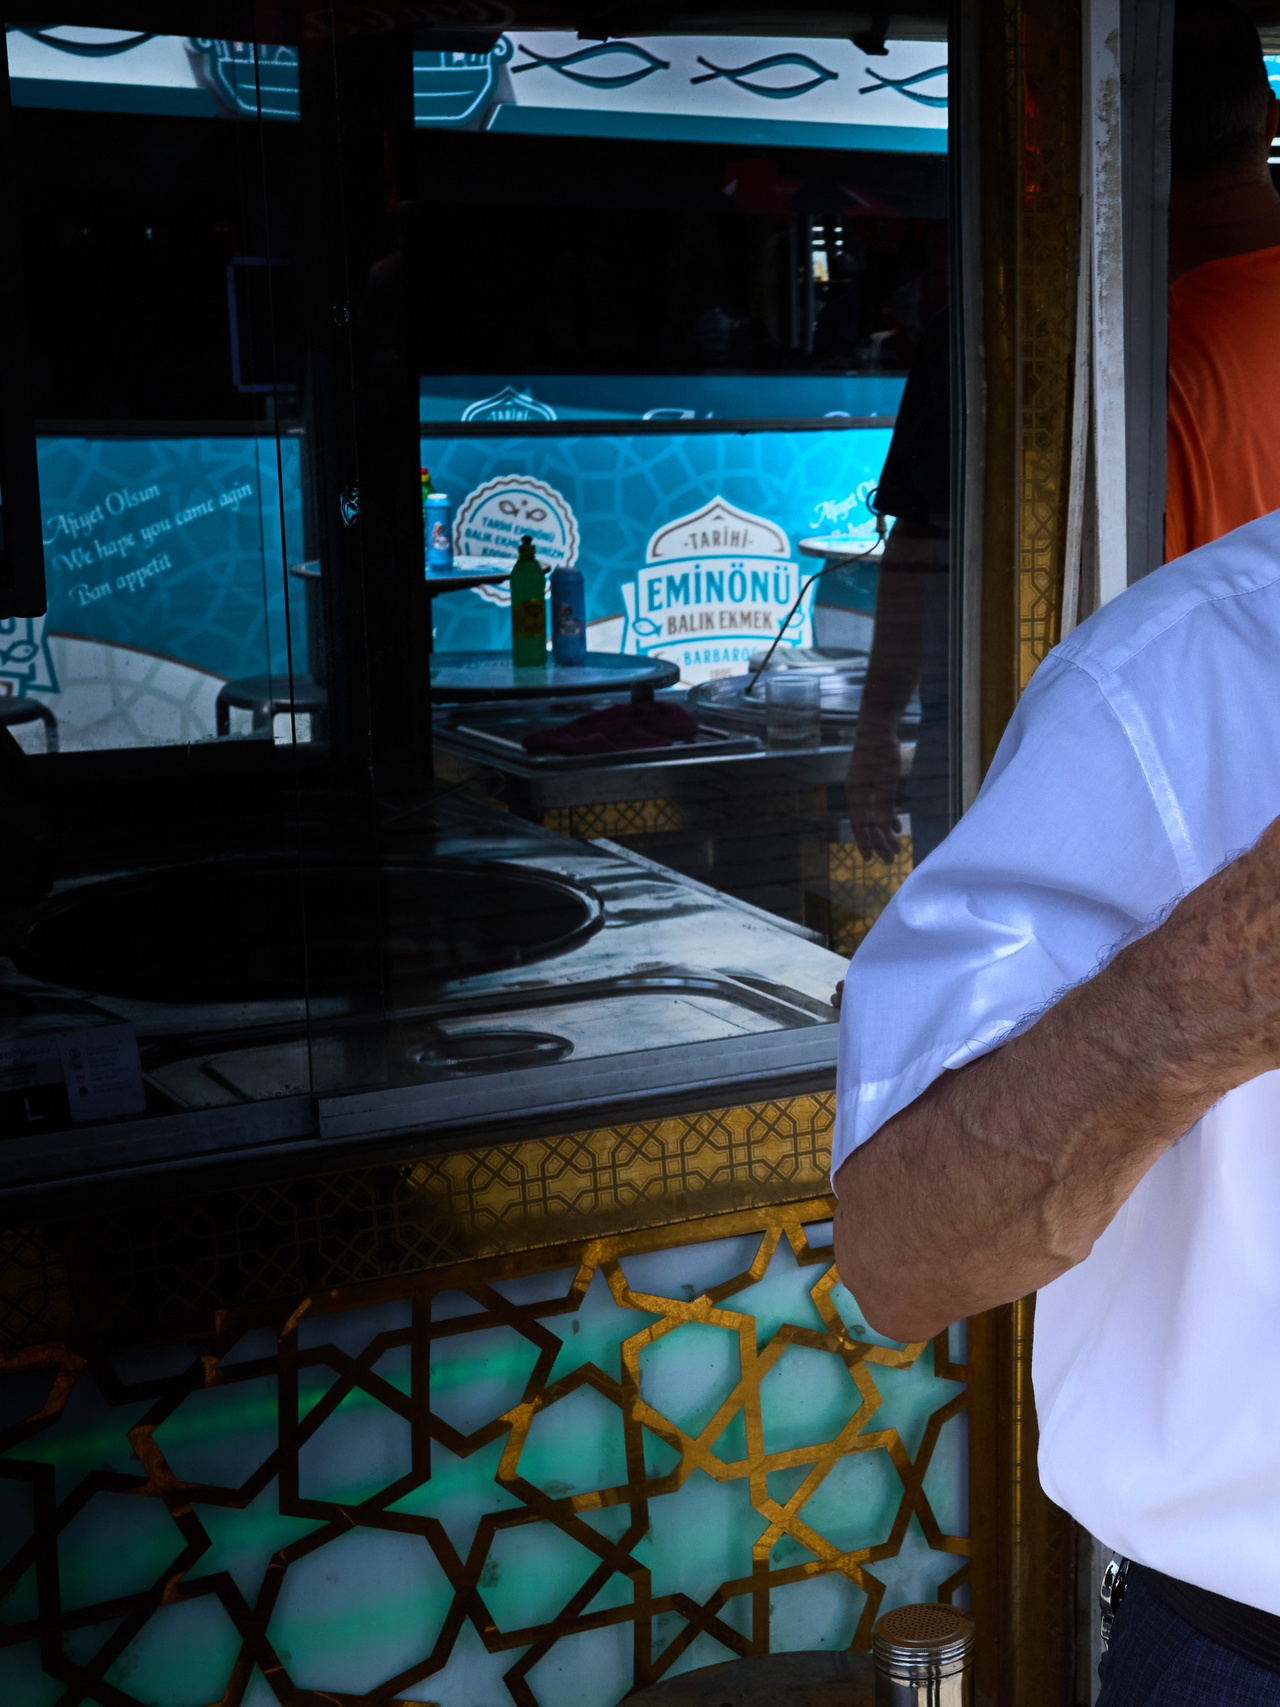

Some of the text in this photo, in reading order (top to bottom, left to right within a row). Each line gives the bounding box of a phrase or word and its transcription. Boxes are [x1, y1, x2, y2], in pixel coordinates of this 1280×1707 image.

[105, 484, 161, 516] Olsun
[141, 518, 171, 548] you
[465, 528, 494, 543] BALIK
[115, 552, 172, 593] appetit
[647, 563, 790, 612] EMİNÖNÜ
[668, 611, 772, 635] BALIK EKMEK
